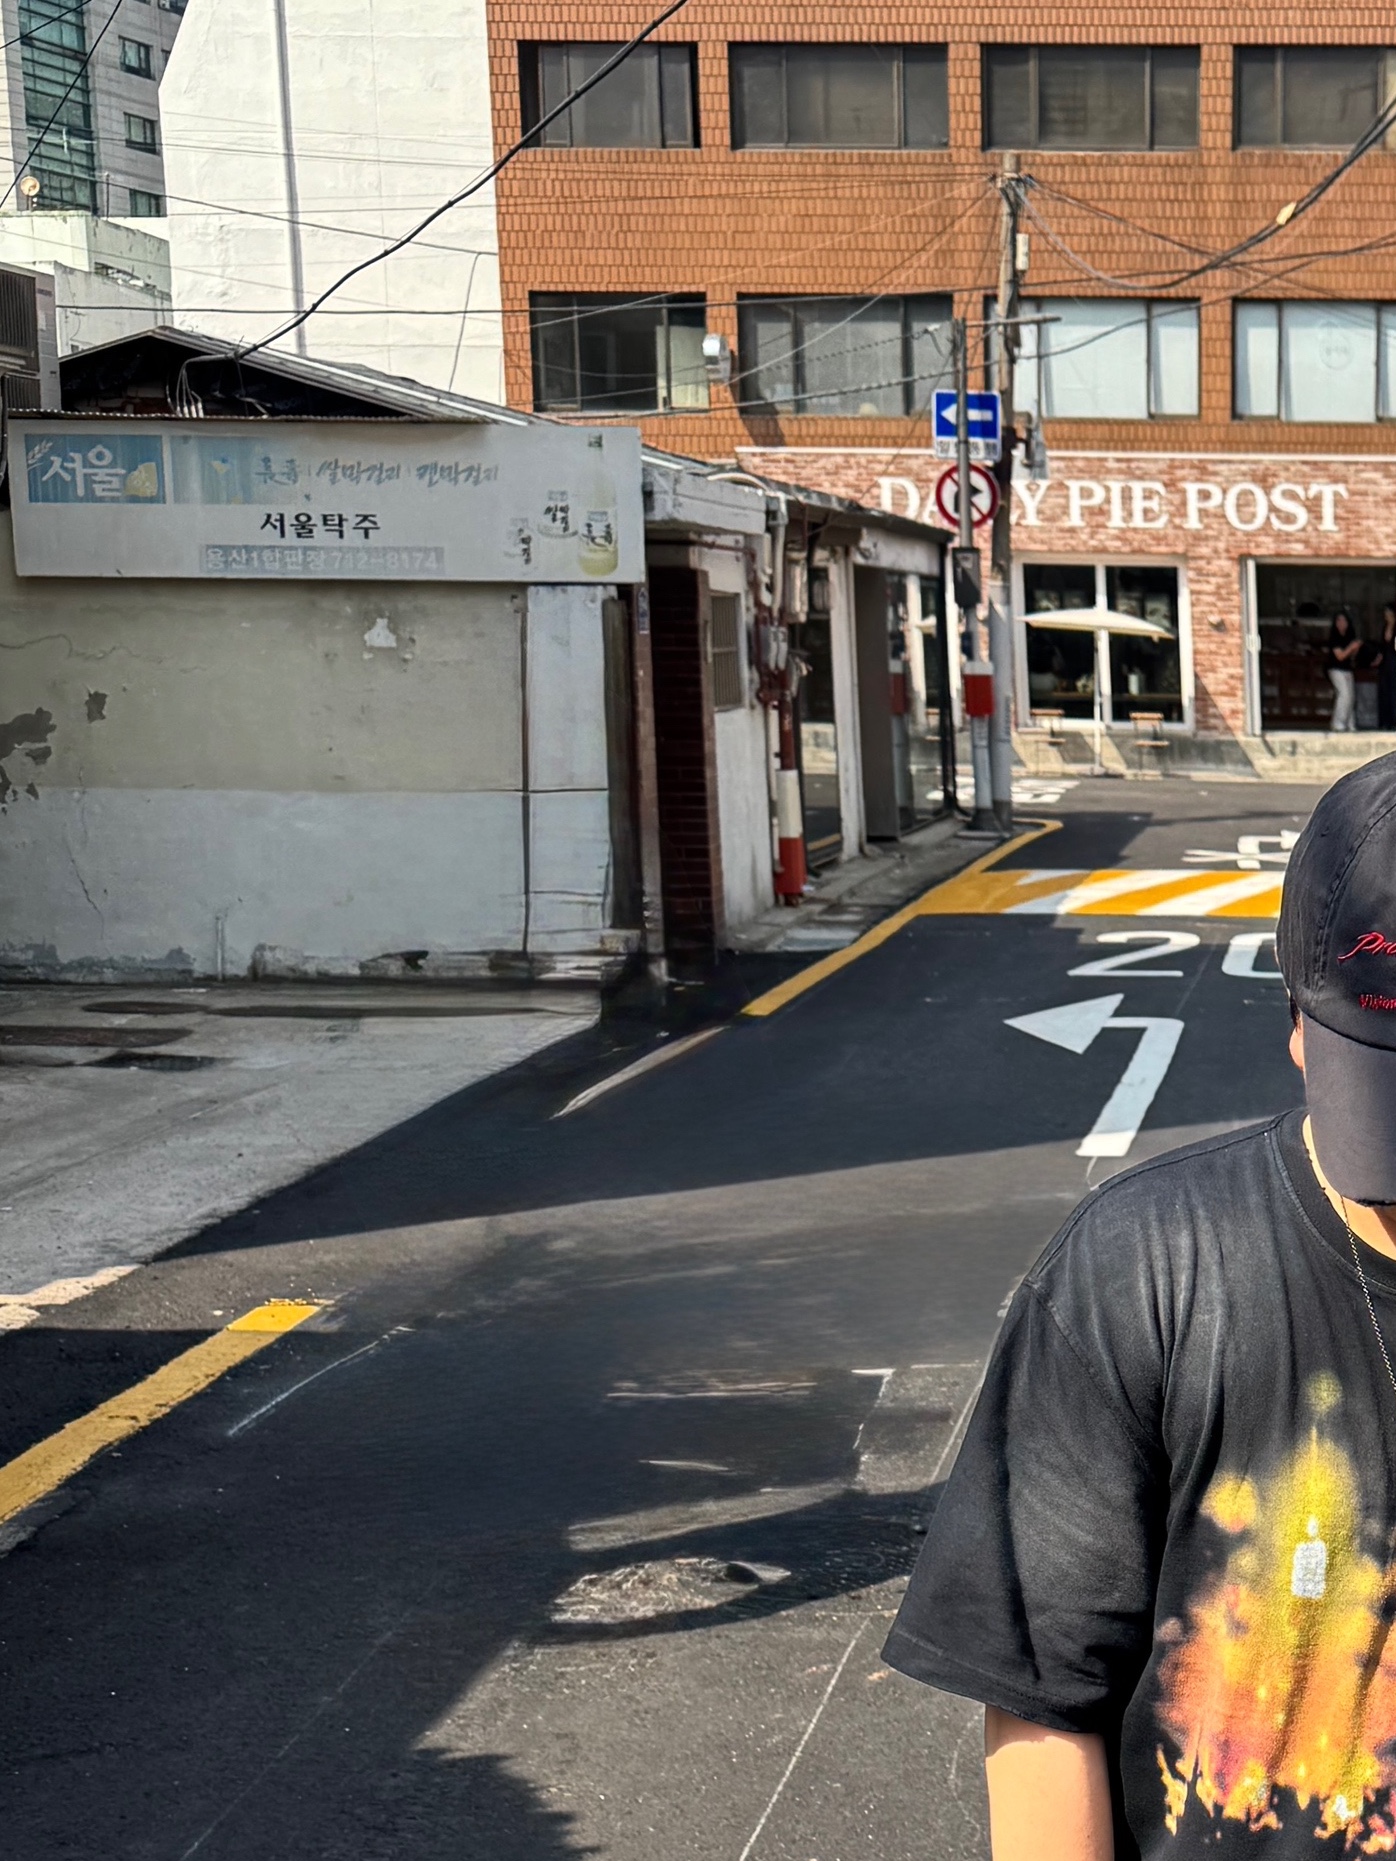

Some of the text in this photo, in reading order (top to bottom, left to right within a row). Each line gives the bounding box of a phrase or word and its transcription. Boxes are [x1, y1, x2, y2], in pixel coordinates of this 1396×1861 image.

[42, 444, 127, 497] 서울
[260, 512, 381, 539] 서울탁주
[1063, 479, 1170, 529] PIE
[1180, 481, 1349, 532] POST
